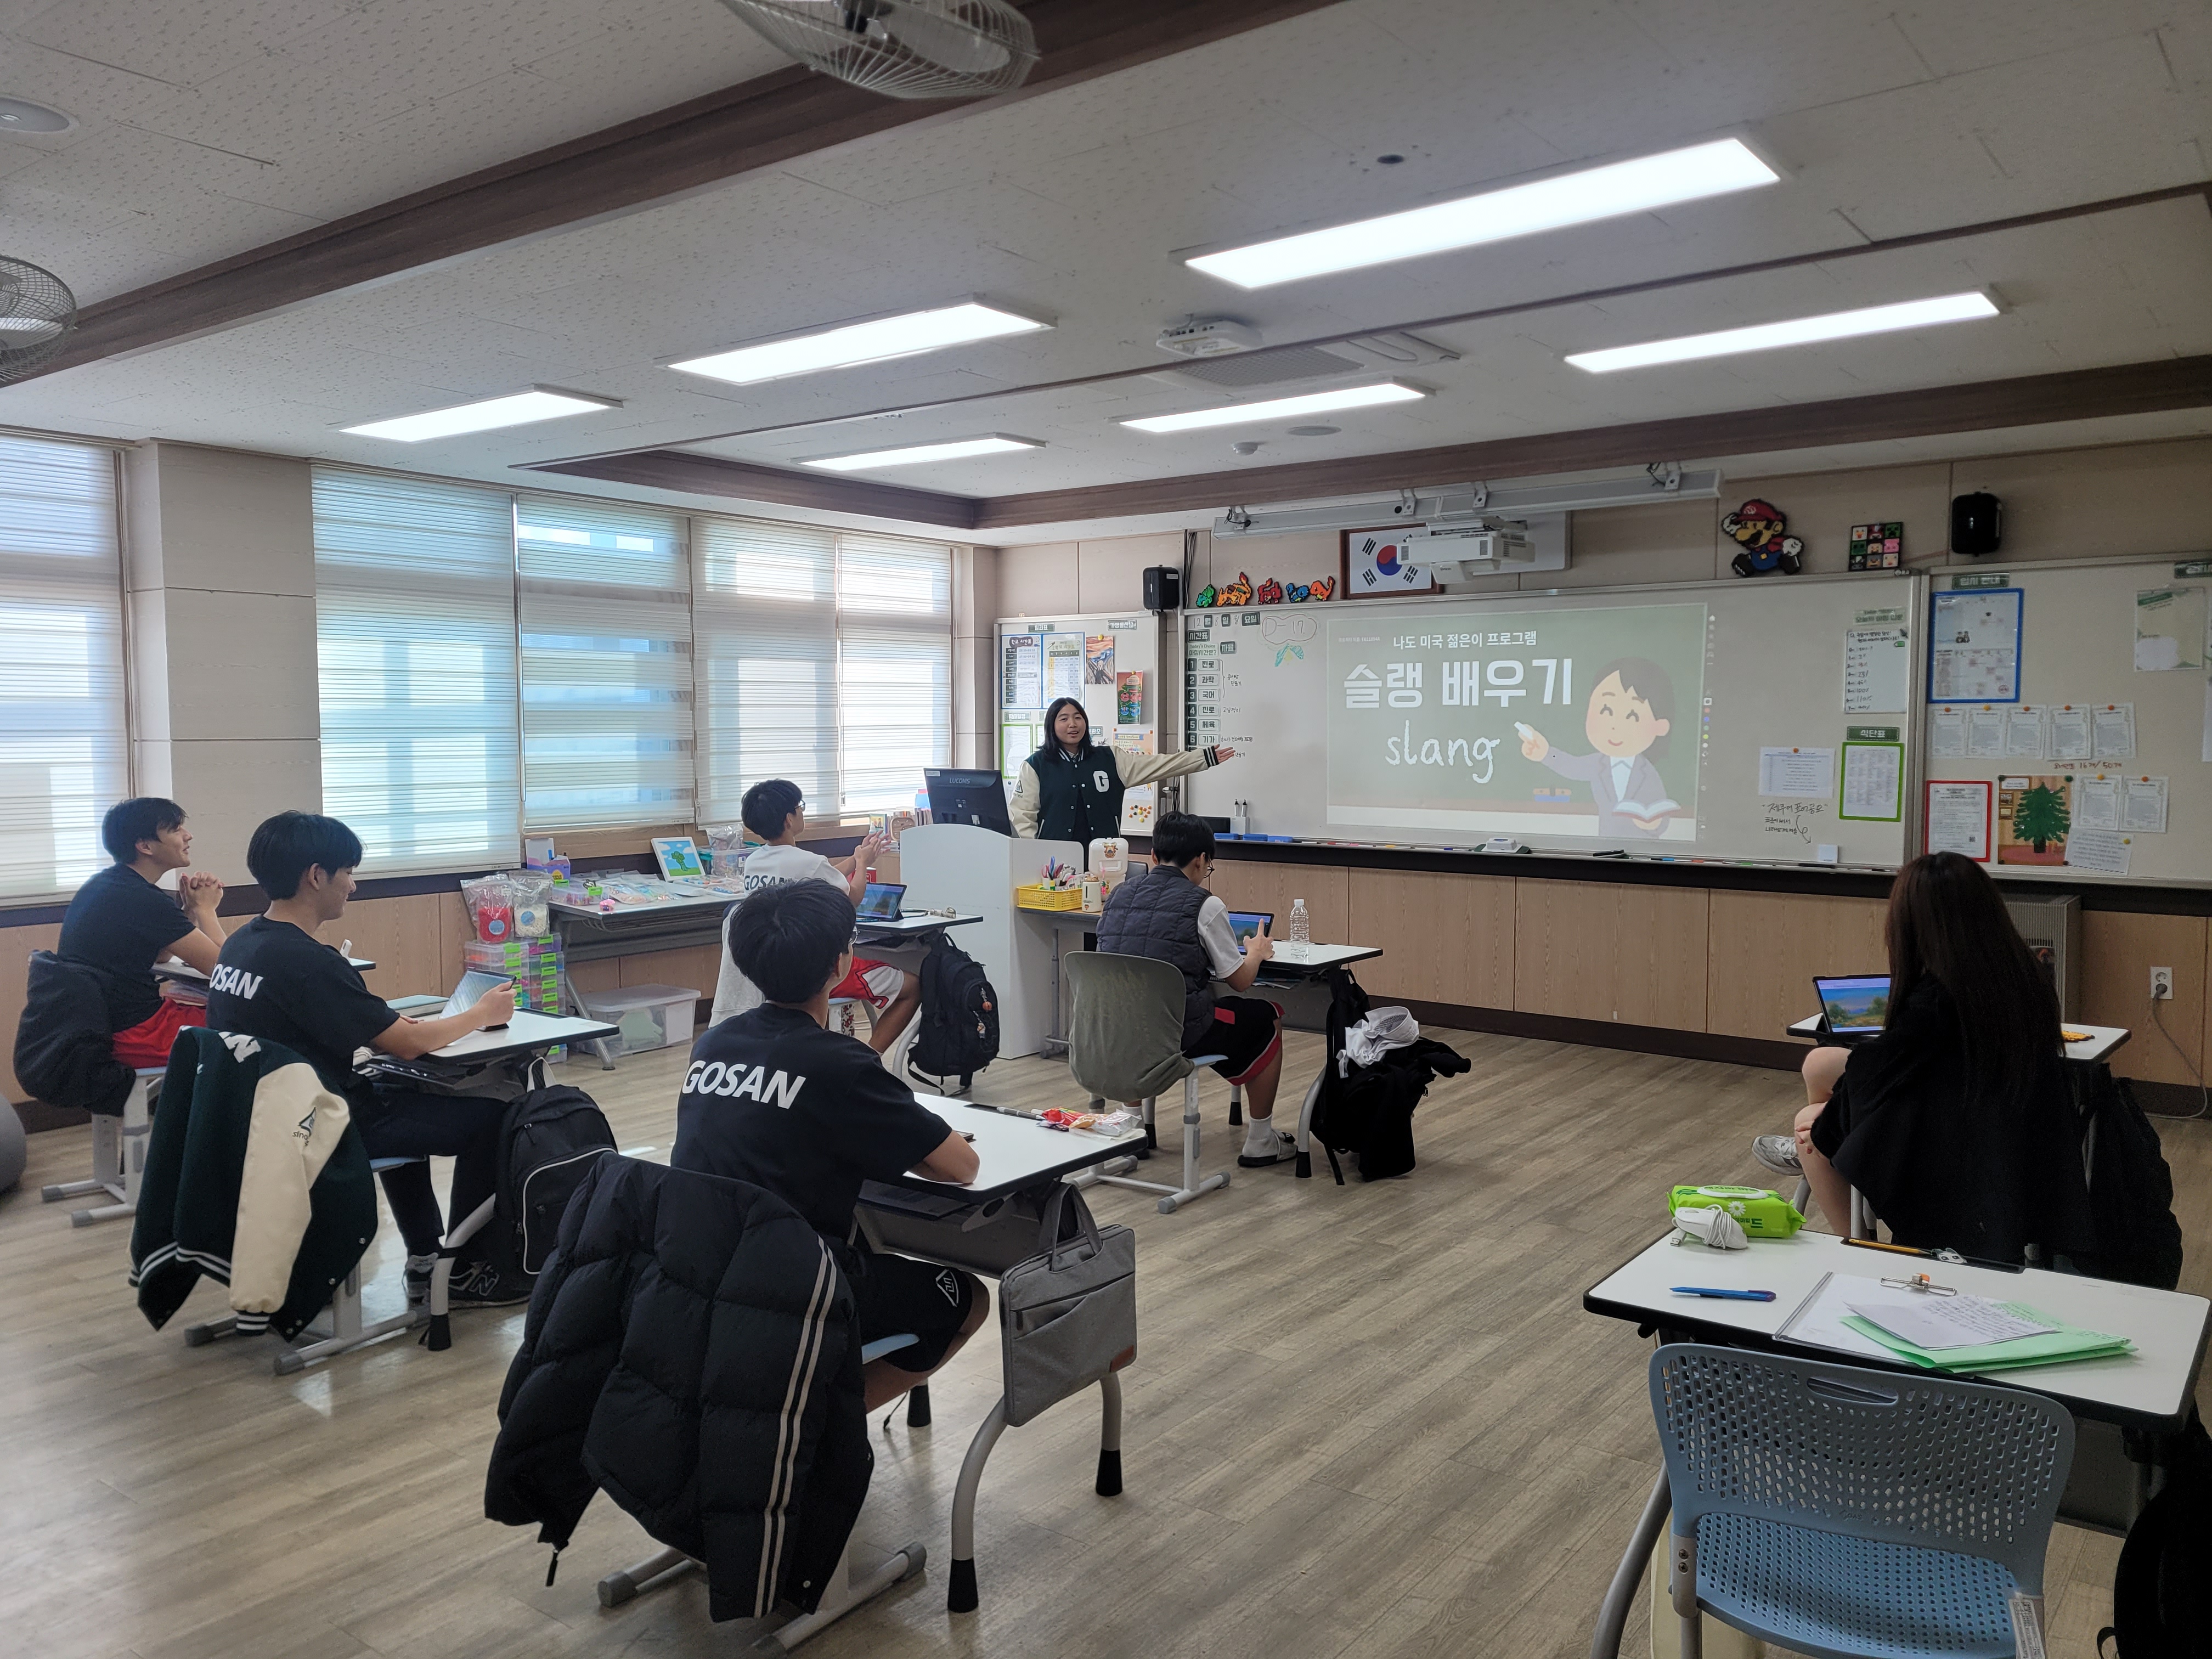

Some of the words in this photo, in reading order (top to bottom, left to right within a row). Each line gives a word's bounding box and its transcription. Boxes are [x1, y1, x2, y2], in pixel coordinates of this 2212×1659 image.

[1244, 615, 1257, 624] 요일
[1189, 631, 1208, 640] 시간표
[1393, 634, 1416, 650] 나도
[1420, 634, 1443, 649] 미국
[1447, 633, 1483, 648] 젊은이
[1487, 630, 1537, 647] 프로그램
[1190, 661, 1194, 669] 1
[1189, 676, 1195, 685] 2
[1344, 662, 1424, 709] 슬랭
[1442, 658, 1572, 708] 배우기
[1189, 691, 1195, 699] 3
[1189, 706, 1195, 714] 4
[1202, 720, 1215, 729] 체육
[1860, 729, 1886, 738] 식단표
[1385, 720, 1501, 784] slang
[1092, 770, 1110, 793] G
[210, 963, 264, 1000] OSAN
[682, 1060, 806, 1109] GOSAN
